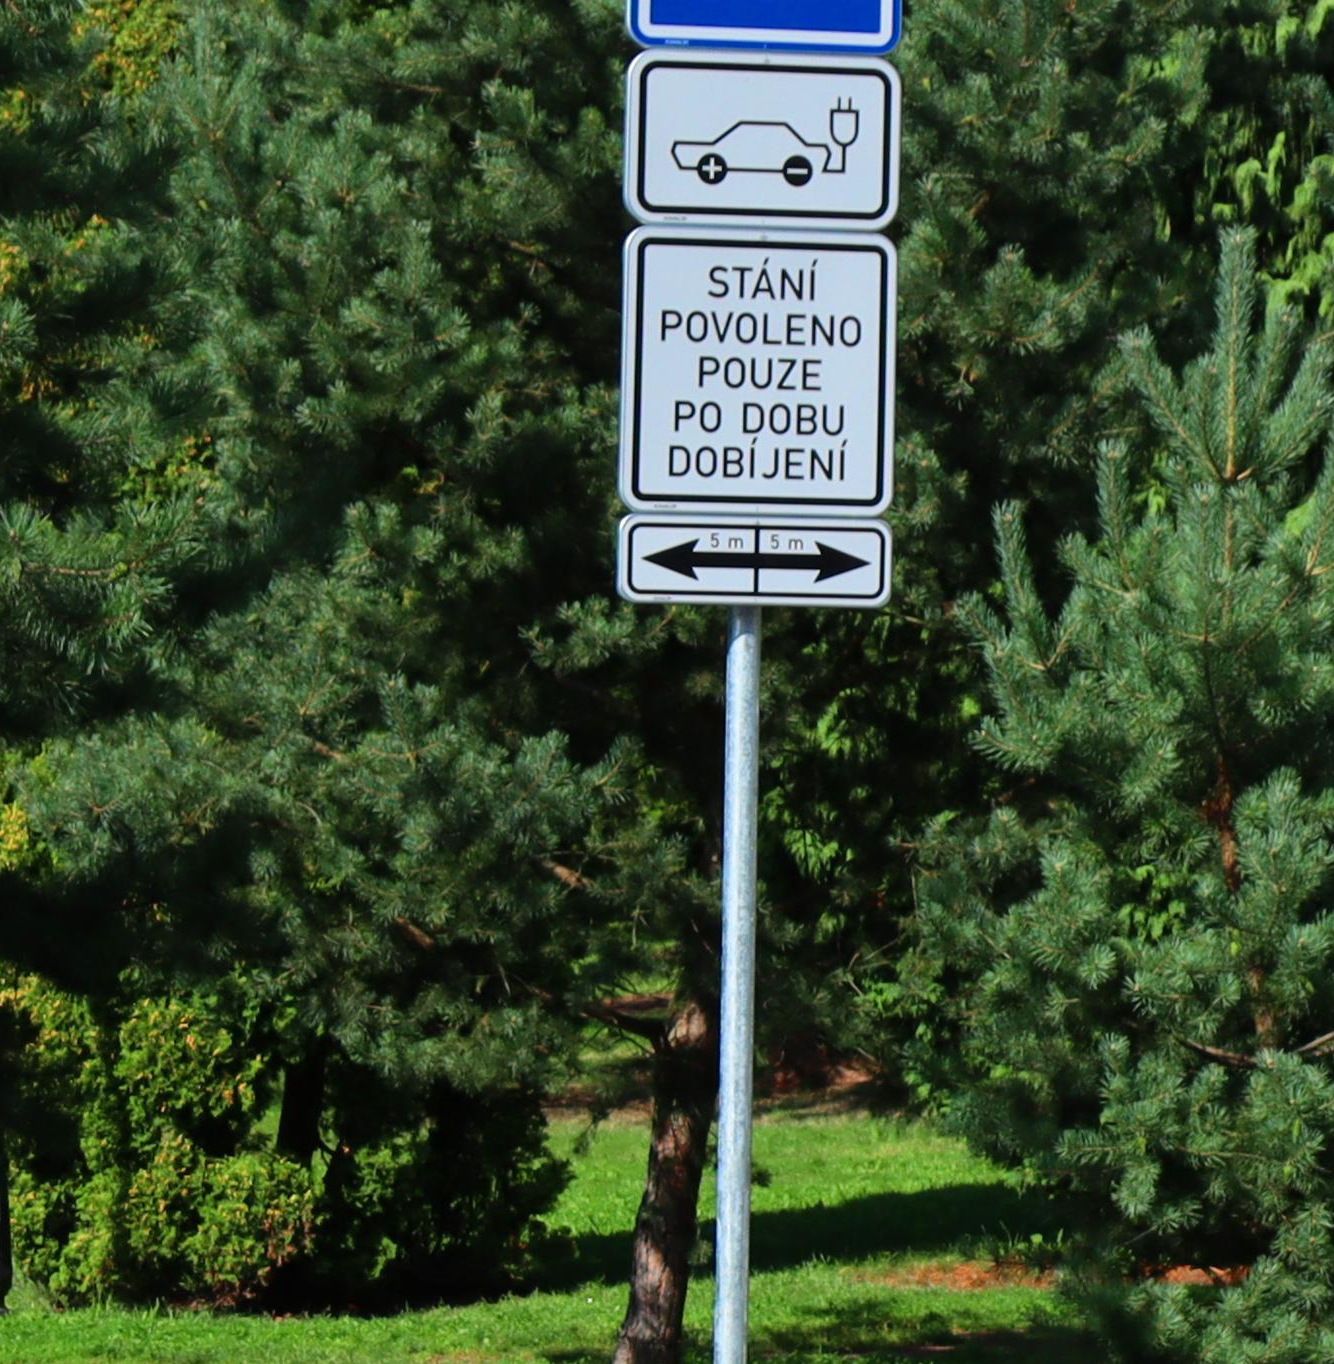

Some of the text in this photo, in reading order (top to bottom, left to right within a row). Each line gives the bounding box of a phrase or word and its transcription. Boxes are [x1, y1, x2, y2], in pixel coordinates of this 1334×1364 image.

[707, 257, 819, 301] STÁNÍ
[660, 309, 862, 347] POVOLENO
[698, 356, 823, 391] POUZE
[674, 400, 845, 436] PO DOBU
[668, 436, 849, 481] DOBÍJENÍ
[710, 533, 744, 549] 5 m
[770, 534, 804, 550] 5 m
